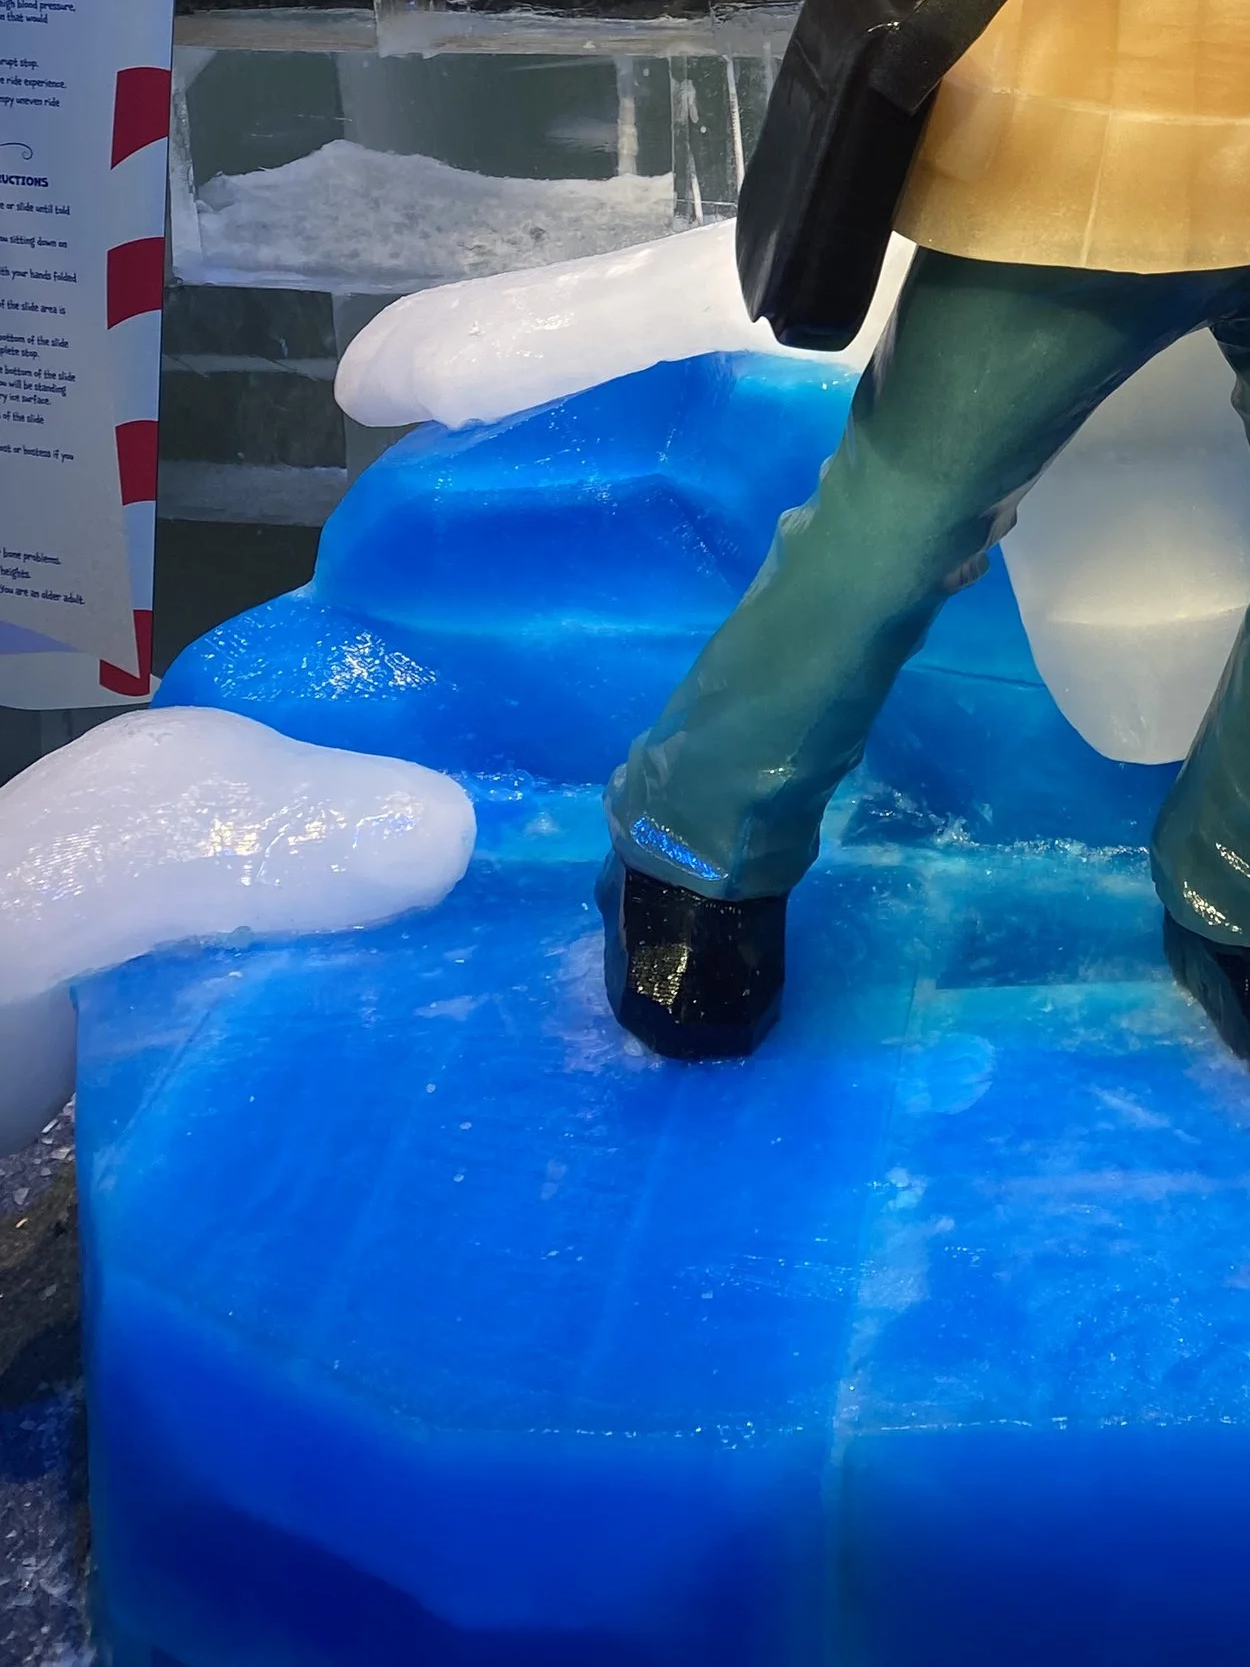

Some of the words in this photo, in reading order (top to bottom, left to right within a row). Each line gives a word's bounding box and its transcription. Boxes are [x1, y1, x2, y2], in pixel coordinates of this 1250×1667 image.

[7, 11, 23, 22] that
[25, 13, 48, 24] would
[6, 75, 22, 86] ride
[16, 97, 42, 106] uneven
[44, 97, 60, 107] ride
[16, 202, 34, 212] slide
[35, 204, 53, 214] until
[55, 205, 71, 215] told
[9, 235, 35, 248] sitting
[37, 236, 57, 247] down
[11, 270, 28, 281] your
[30, 268, 51, 280] hands
[53, 271, 77, 283] folded
[7, 299, 19, 310] the
[21, 301, 39, 312] slide
[41, 305, 57, 314] area
[59, 306, 66, 314] is
[27, 335, 35, 345] of
[37, 335, 49, 346] the
[51, 338, 69, 348] slide
[5, 365, 32, 376] bottom
[34, 369, 42, 379] of
[44, 370, 56, 380] the
[58, 371, 75, 382] slide
[9, 380, 21, 389] will
[23, 379, 33, 390] be
[34, 382, 67, 397] standing
[3, 411, 11, 421] of
[13, 412, 25, 422] the
[27, 414, 44, 424] slide
[23, 445, 51, 458] hostess
[53, 449, 59, 459] if
[61, 453, 74, 463] you
[3, 547, 21, 560] bone
[15, 588, 29, 597] are
[30, 589, 40, 599] an
